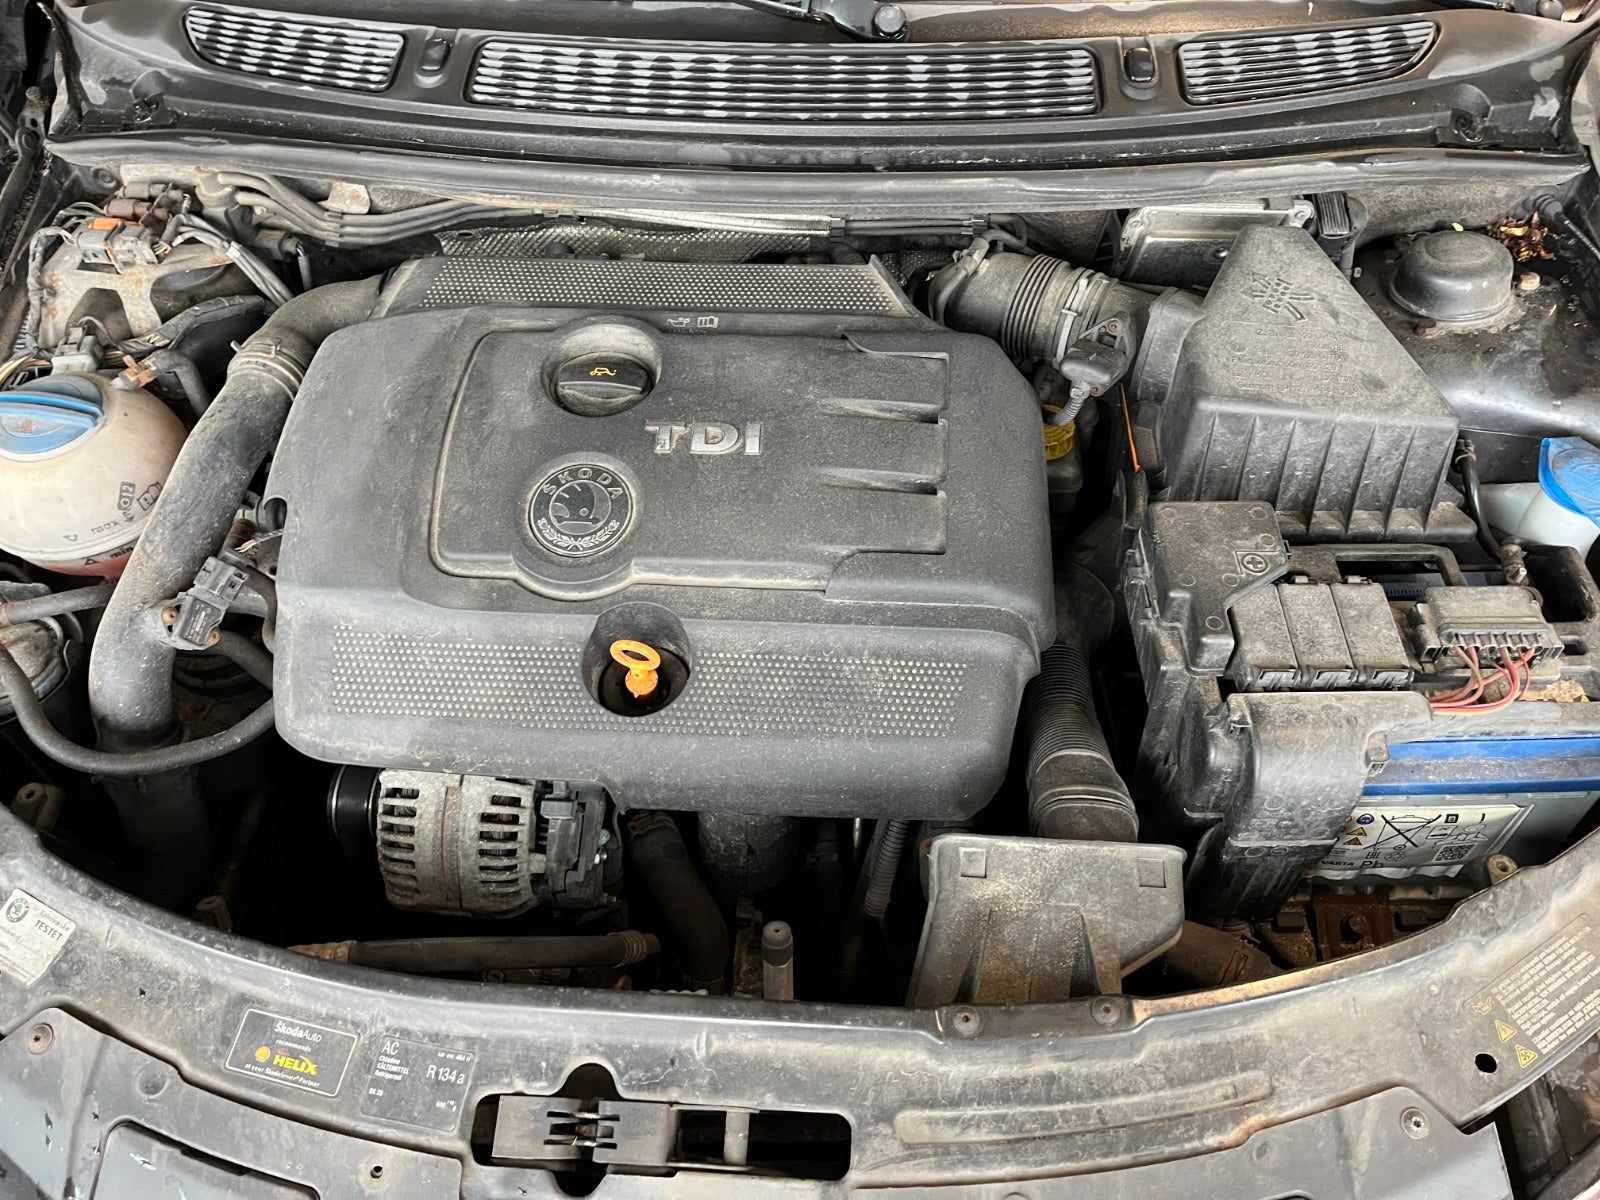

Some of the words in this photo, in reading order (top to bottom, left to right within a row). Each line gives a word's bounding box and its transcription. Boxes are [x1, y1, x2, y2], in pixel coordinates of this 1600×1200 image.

[644, 419, 763, 455] TDI
[1360, 860, 1384, 869] Pb
[35, 919, 64, 941] TESTET
[381, 1040, 400, 1055] AC
[272, 1054, 318, 1076] HELIX
